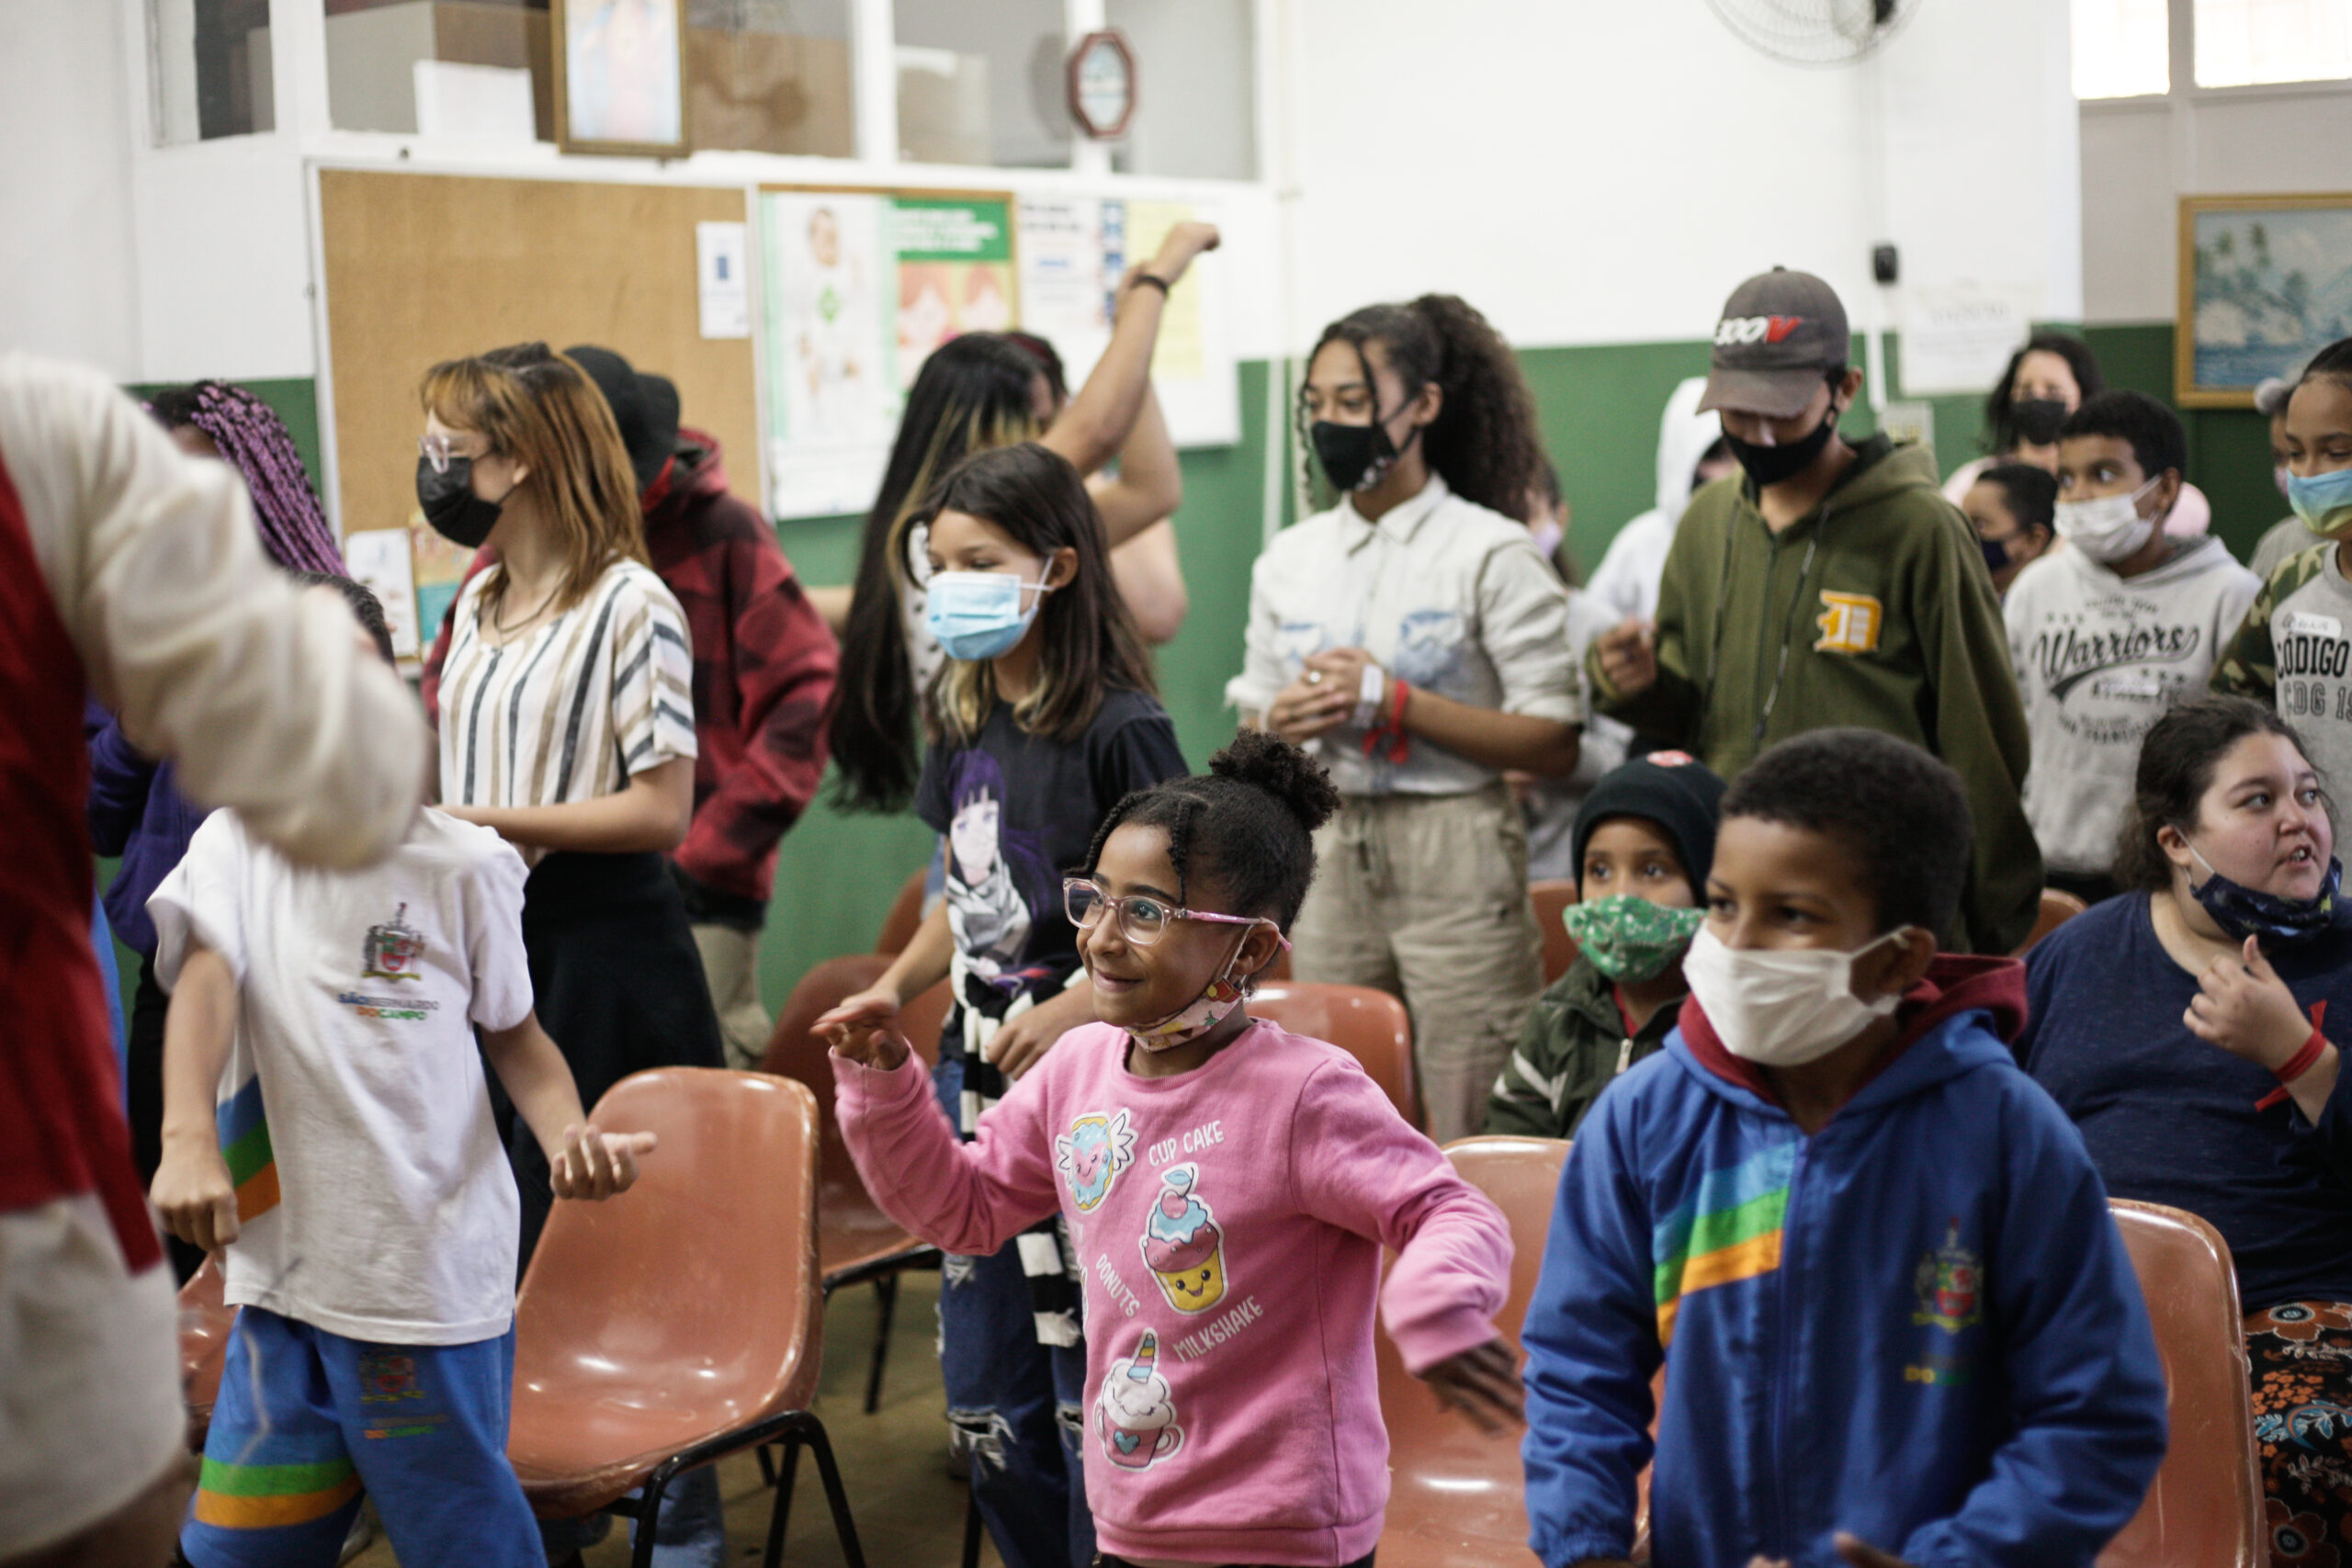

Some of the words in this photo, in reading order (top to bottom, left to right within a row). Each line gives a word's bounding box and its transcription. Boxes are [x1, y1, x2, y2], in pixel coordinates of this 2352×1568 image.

[2030, 623, 2199, 685] Warriors
[2276, 630, 2350, 680] CÓDIGO
[2284, 680, 2326, 716] CDG
[1148, 1138, 1177, 1167] CUP
[1183, 1120, 1226, 1154] CAKE
[1095, 1253, 1141, 1318] DONUTS
[1172, 1295, 1264, 1363] MILKSHAKE
